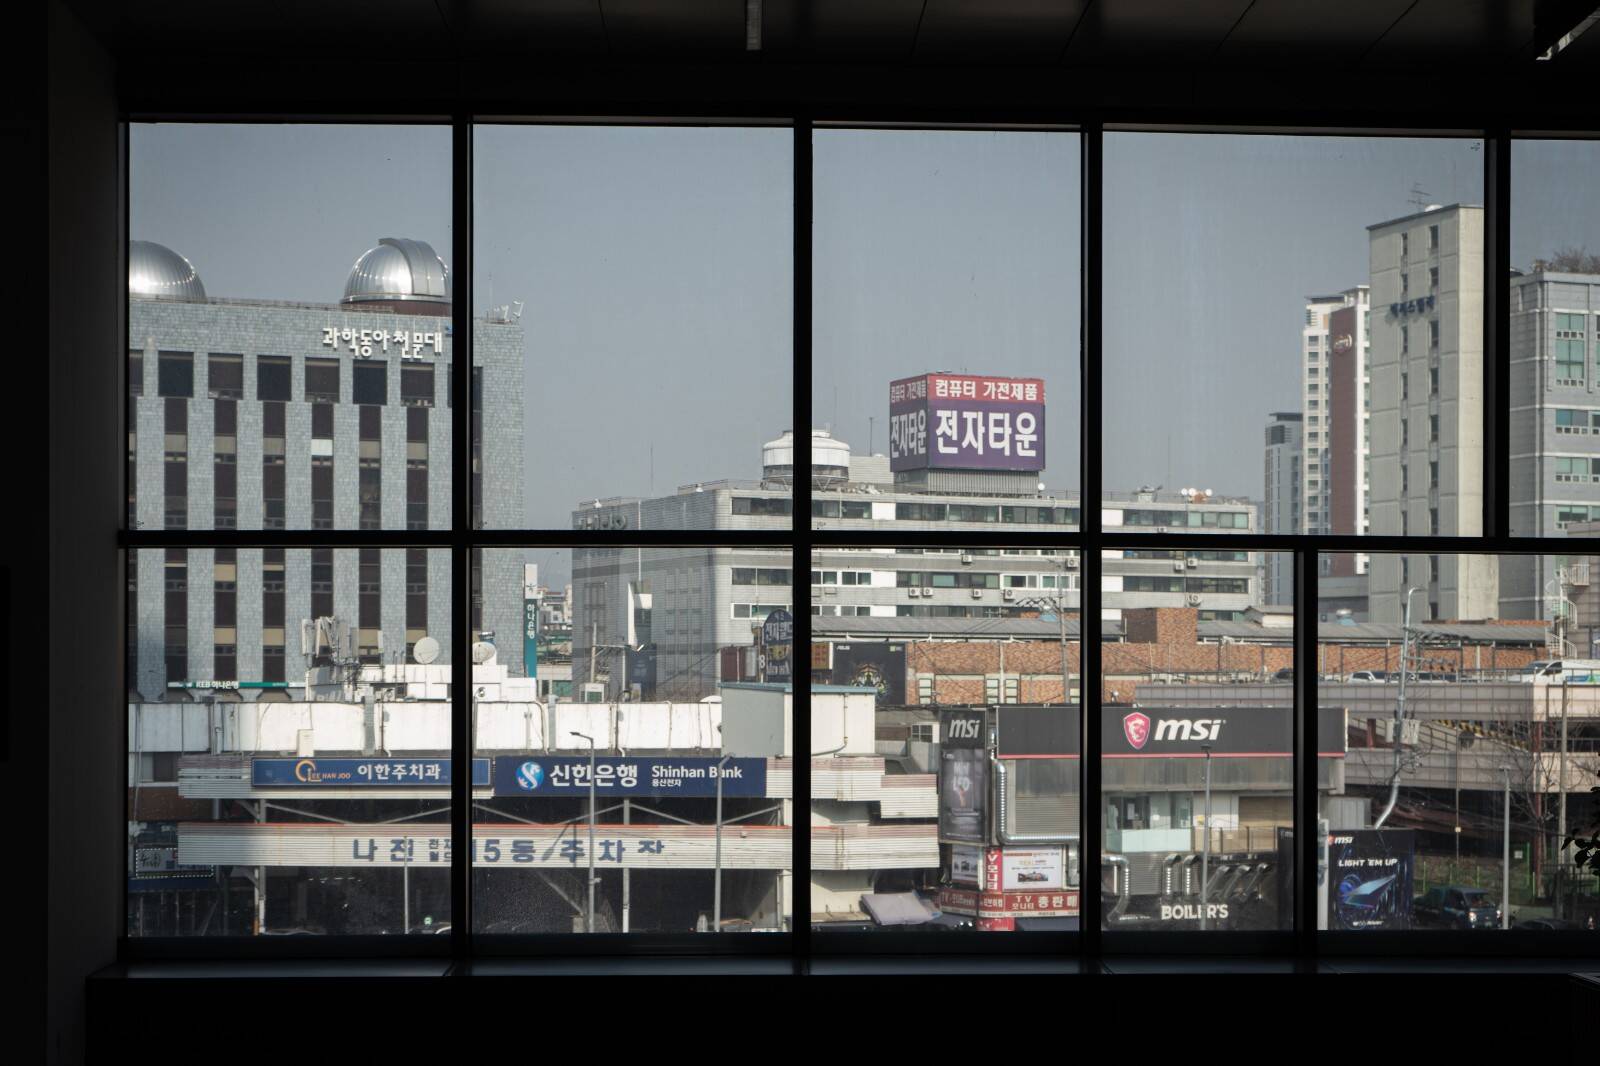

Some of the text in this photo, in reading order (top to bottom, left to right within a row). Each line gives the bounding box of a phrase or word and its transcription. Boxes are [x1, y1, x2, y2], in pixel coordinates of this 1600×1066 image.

[322, 327, 442, 359] 과학동아 천문대
[935, 379, 1038, 401] 컴퓨터 가전제품
[890, 409, 927, 458] 전자타운
[935, 410, 1038, 457] 전자타운
[527, 604, 535, 639] 하나은행
[212, 680, 240, 690] 하나은행
[948, 719, 980, 739] msi
[1154, 720, 1222, 741] msi
[357, 764, 441, 780] 이한주치과
[549, 764, 638, 788] 신한은행
[651, 765, 705, 779] Shinhan
